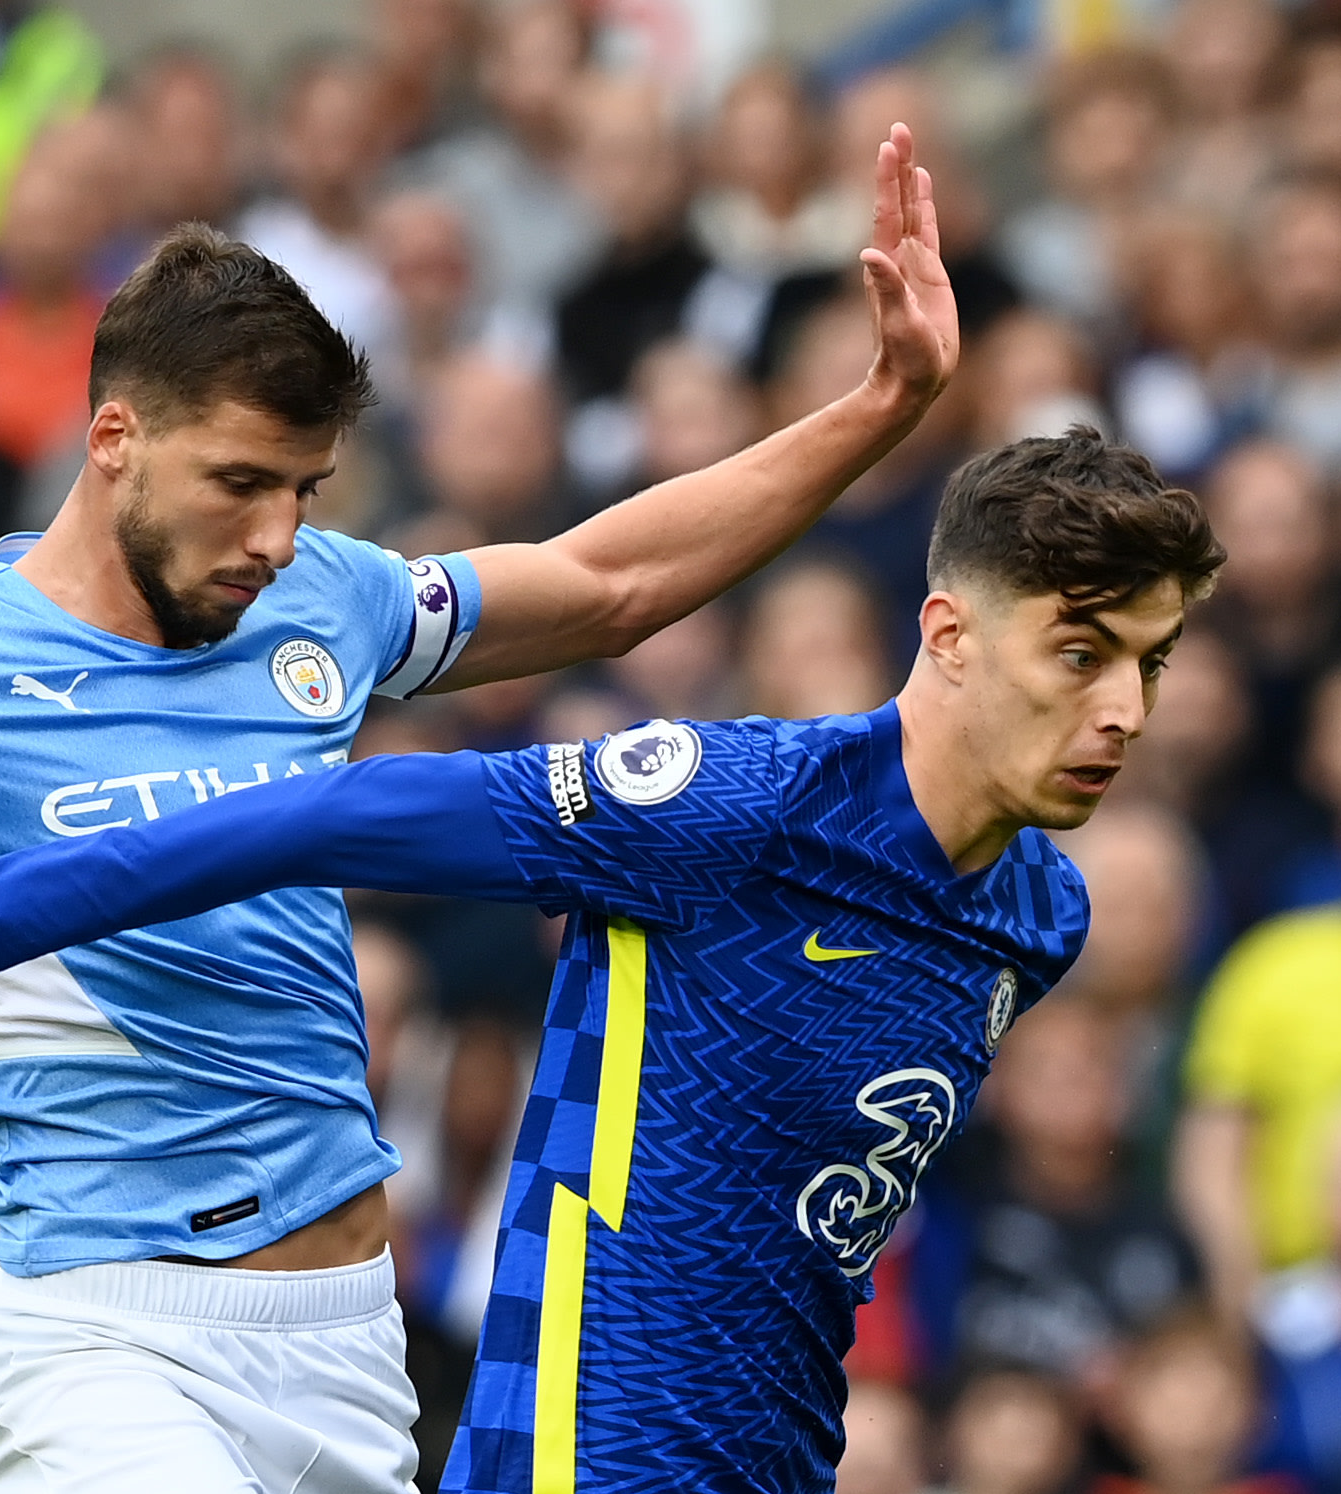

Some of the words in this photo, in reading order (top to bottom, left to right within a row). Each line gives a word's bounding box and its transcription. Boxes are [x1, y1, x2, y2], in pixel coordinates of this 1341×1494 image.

[275, 642, 329, 676] MANCHESTER
[314, 705, 333, 715] CITY
[563, 756, 589, 813] room
[627, 780, 660, 793] League
